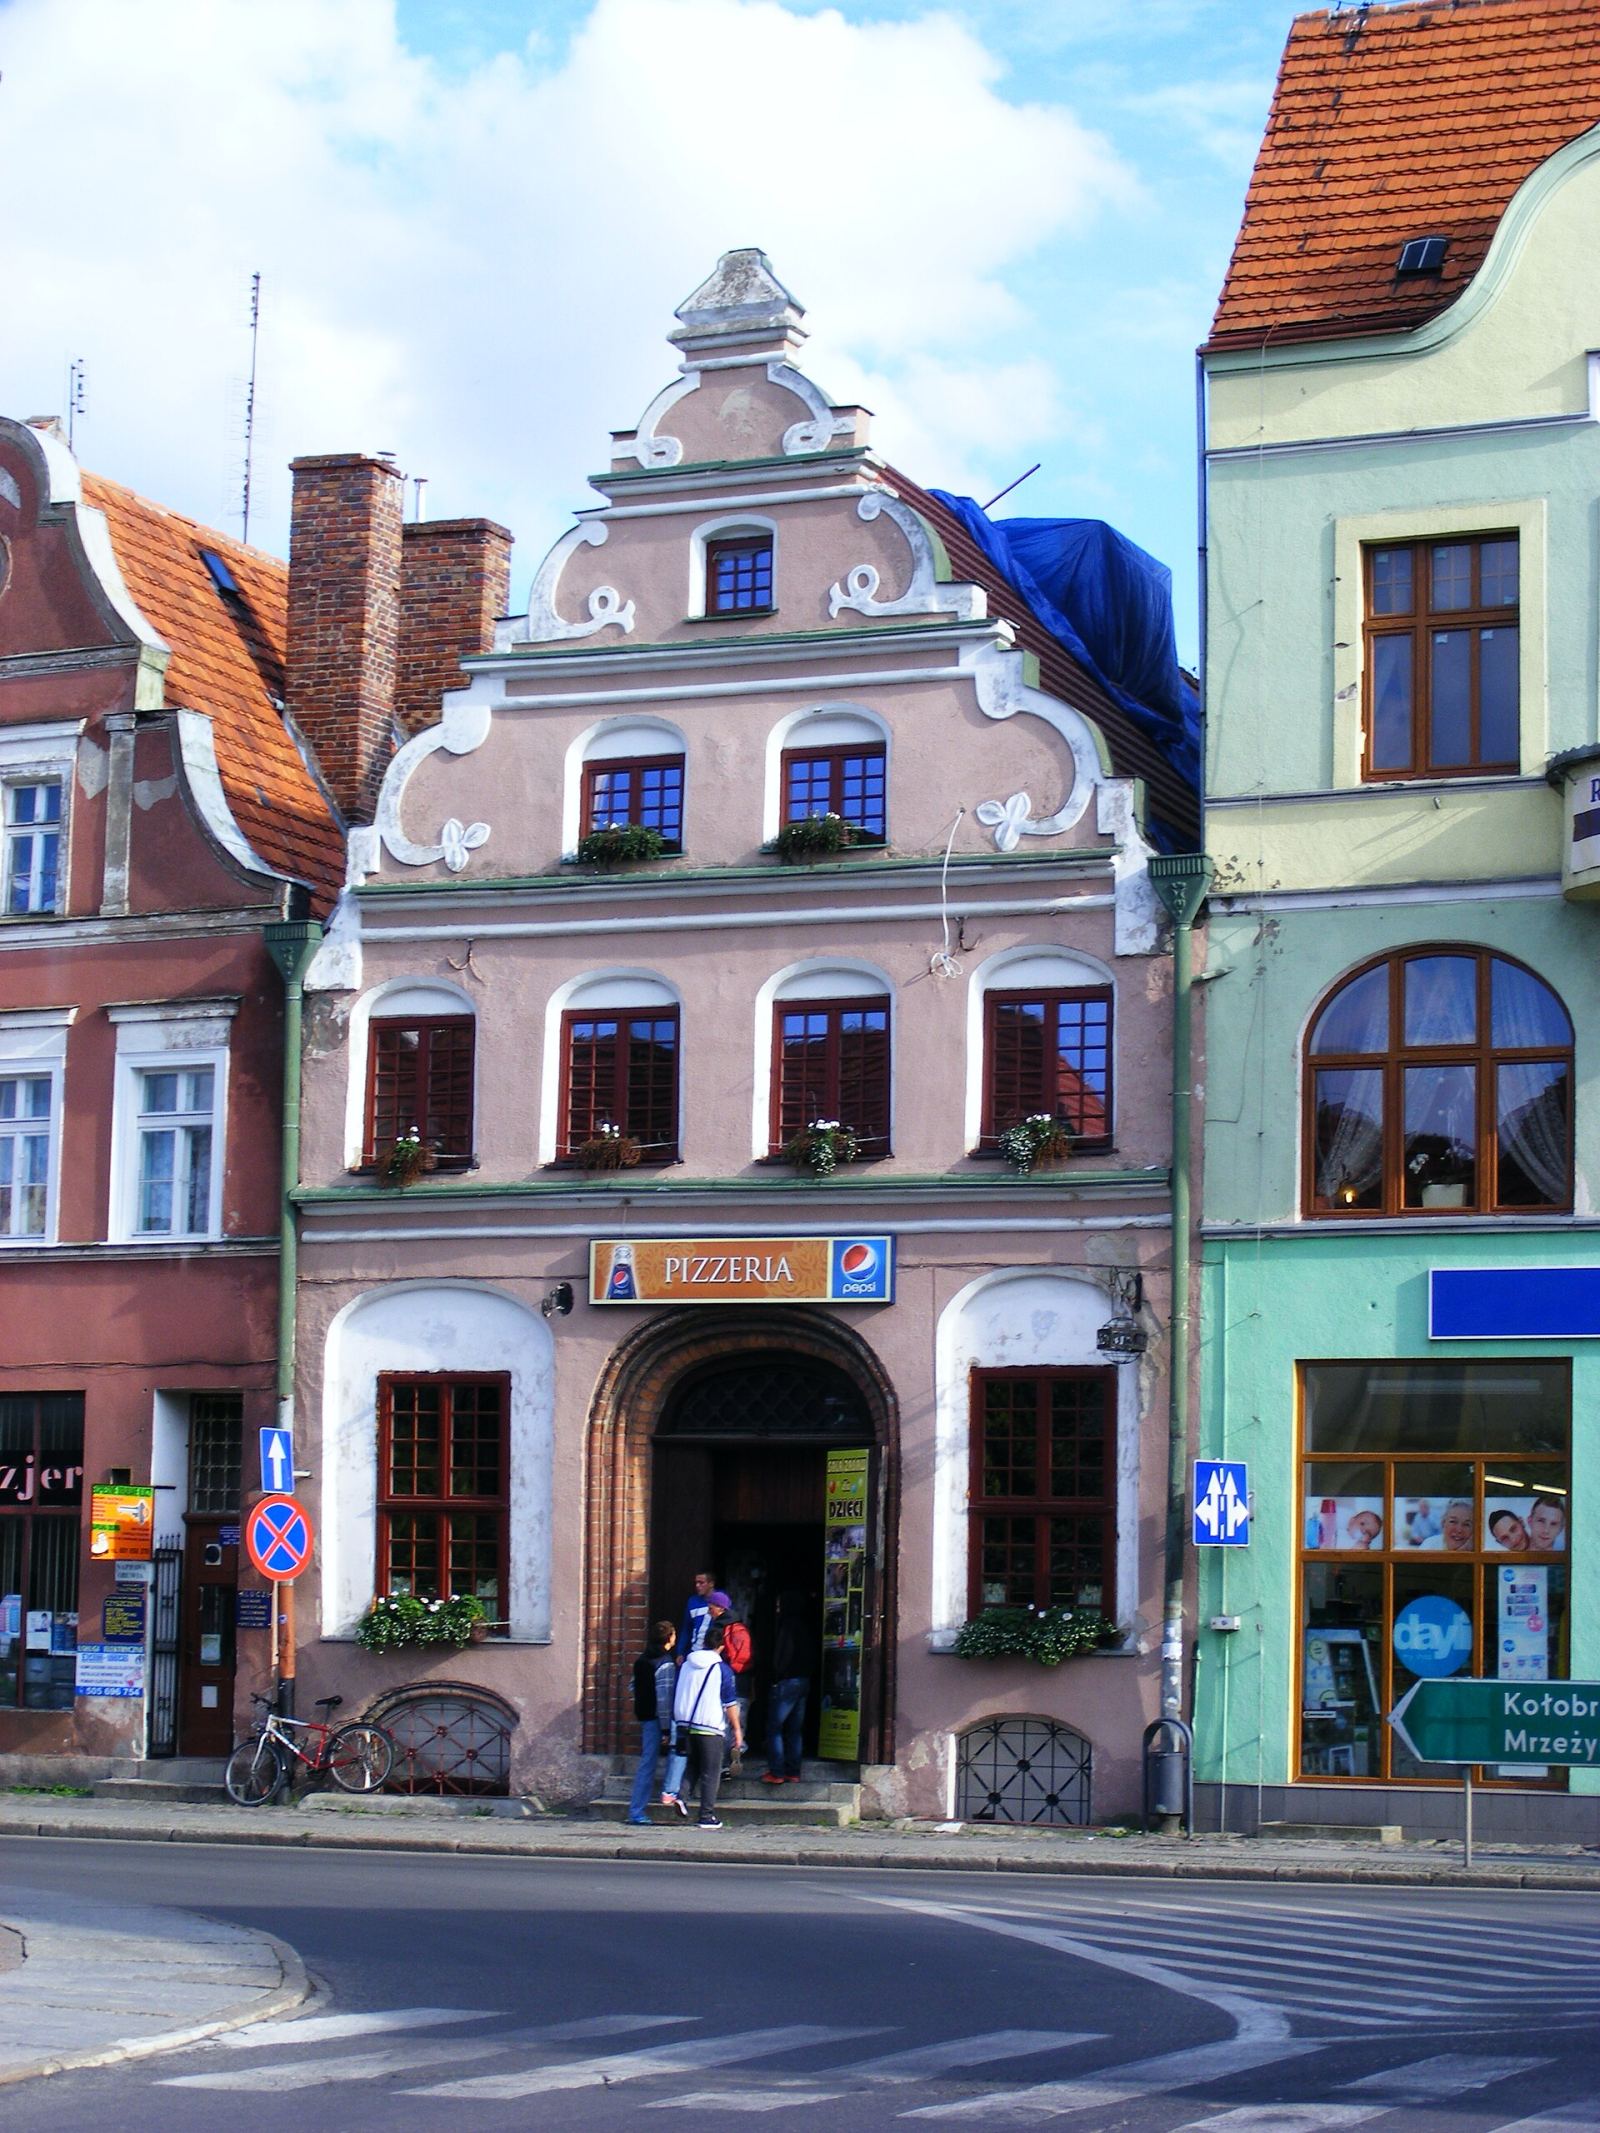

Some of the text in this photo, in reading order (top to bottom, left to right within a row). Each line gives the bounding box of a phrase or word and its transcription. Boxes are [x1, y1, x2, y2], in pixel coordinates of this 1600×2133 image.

[664, 1256, 795, 1284] PIZZERIA
[842, 1282, 877, 1294] pepsi
[828, 1500, 864, 1518] DZIECI
[1394, 1611, 1472, 1660] dayli
[1504, 1692, 1600, 1717] Kołobr
[1504, 1729, 1598, 1761] Mrzeży
